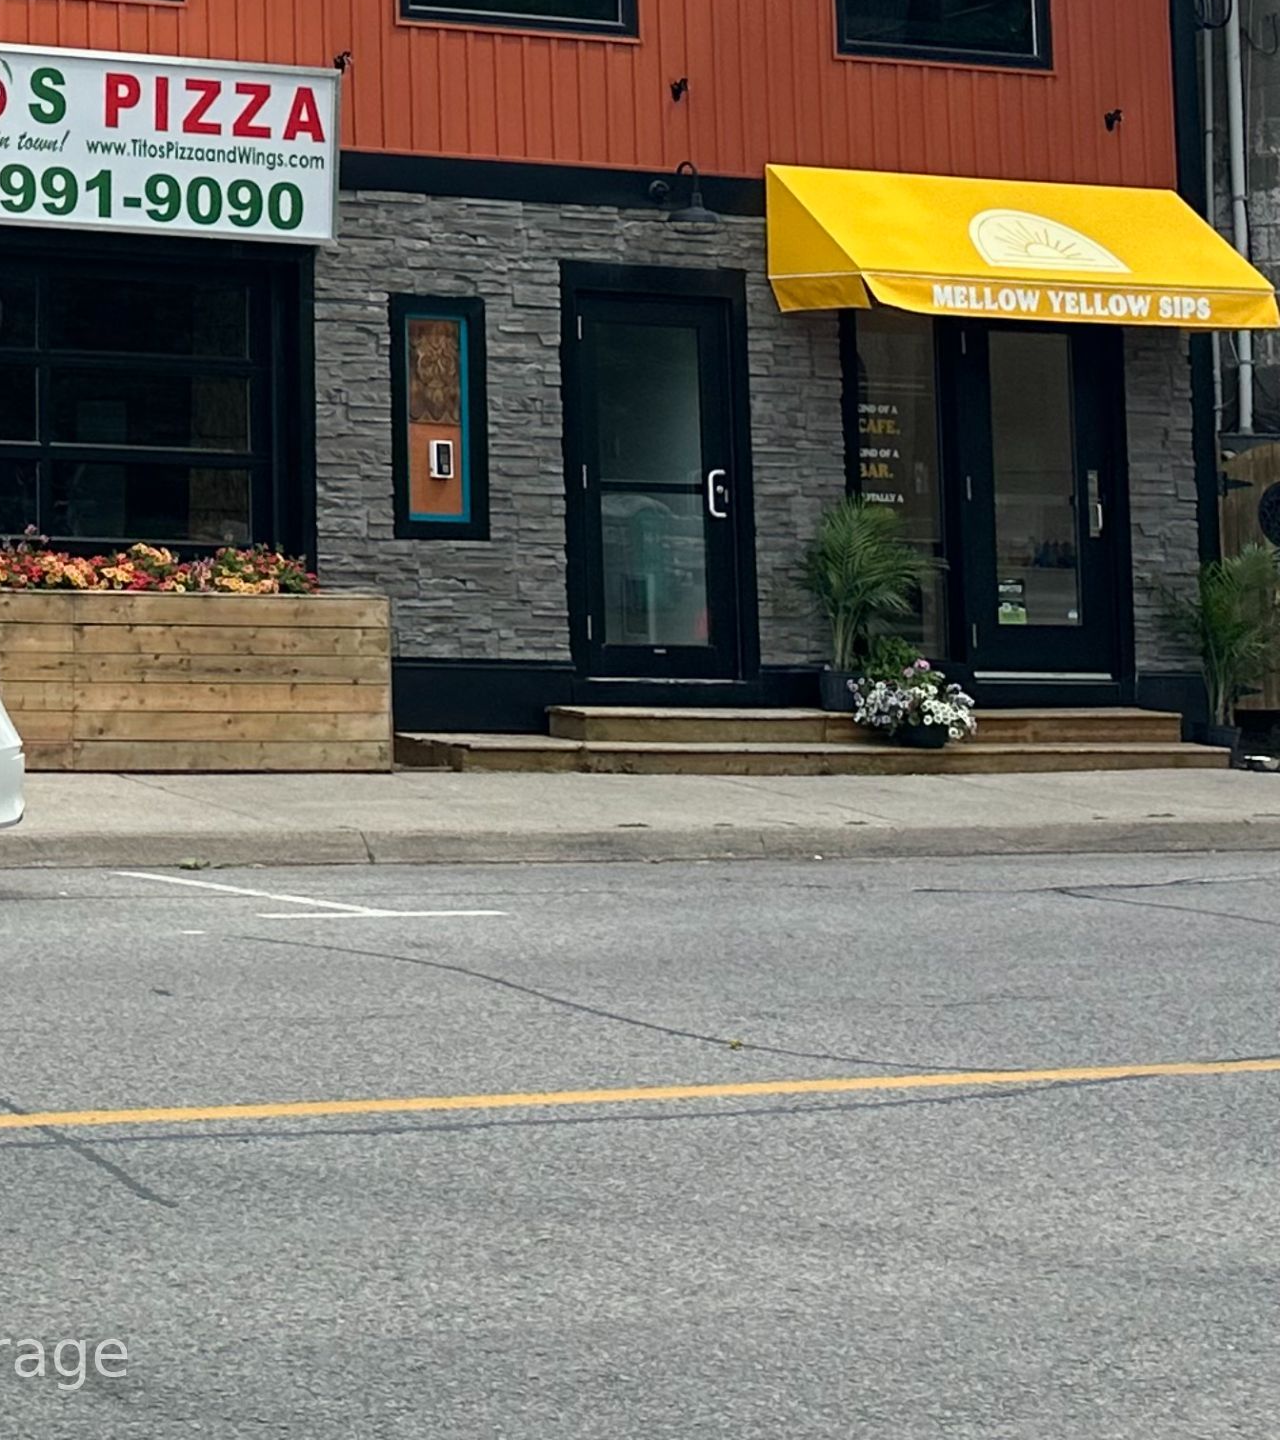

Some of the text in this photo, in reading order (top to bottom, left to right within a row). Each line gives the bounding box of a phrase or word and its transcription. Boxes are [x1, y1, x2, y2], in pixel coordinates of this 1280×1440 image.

[104, 72, 326, 143] PIZZA
[16, 129, 71, 152] town!
[86, 138, 325, 170] www.TitosPizzaandWings.com
[931, 284, 1211, 320] MELLOW YELLOW SIPS
